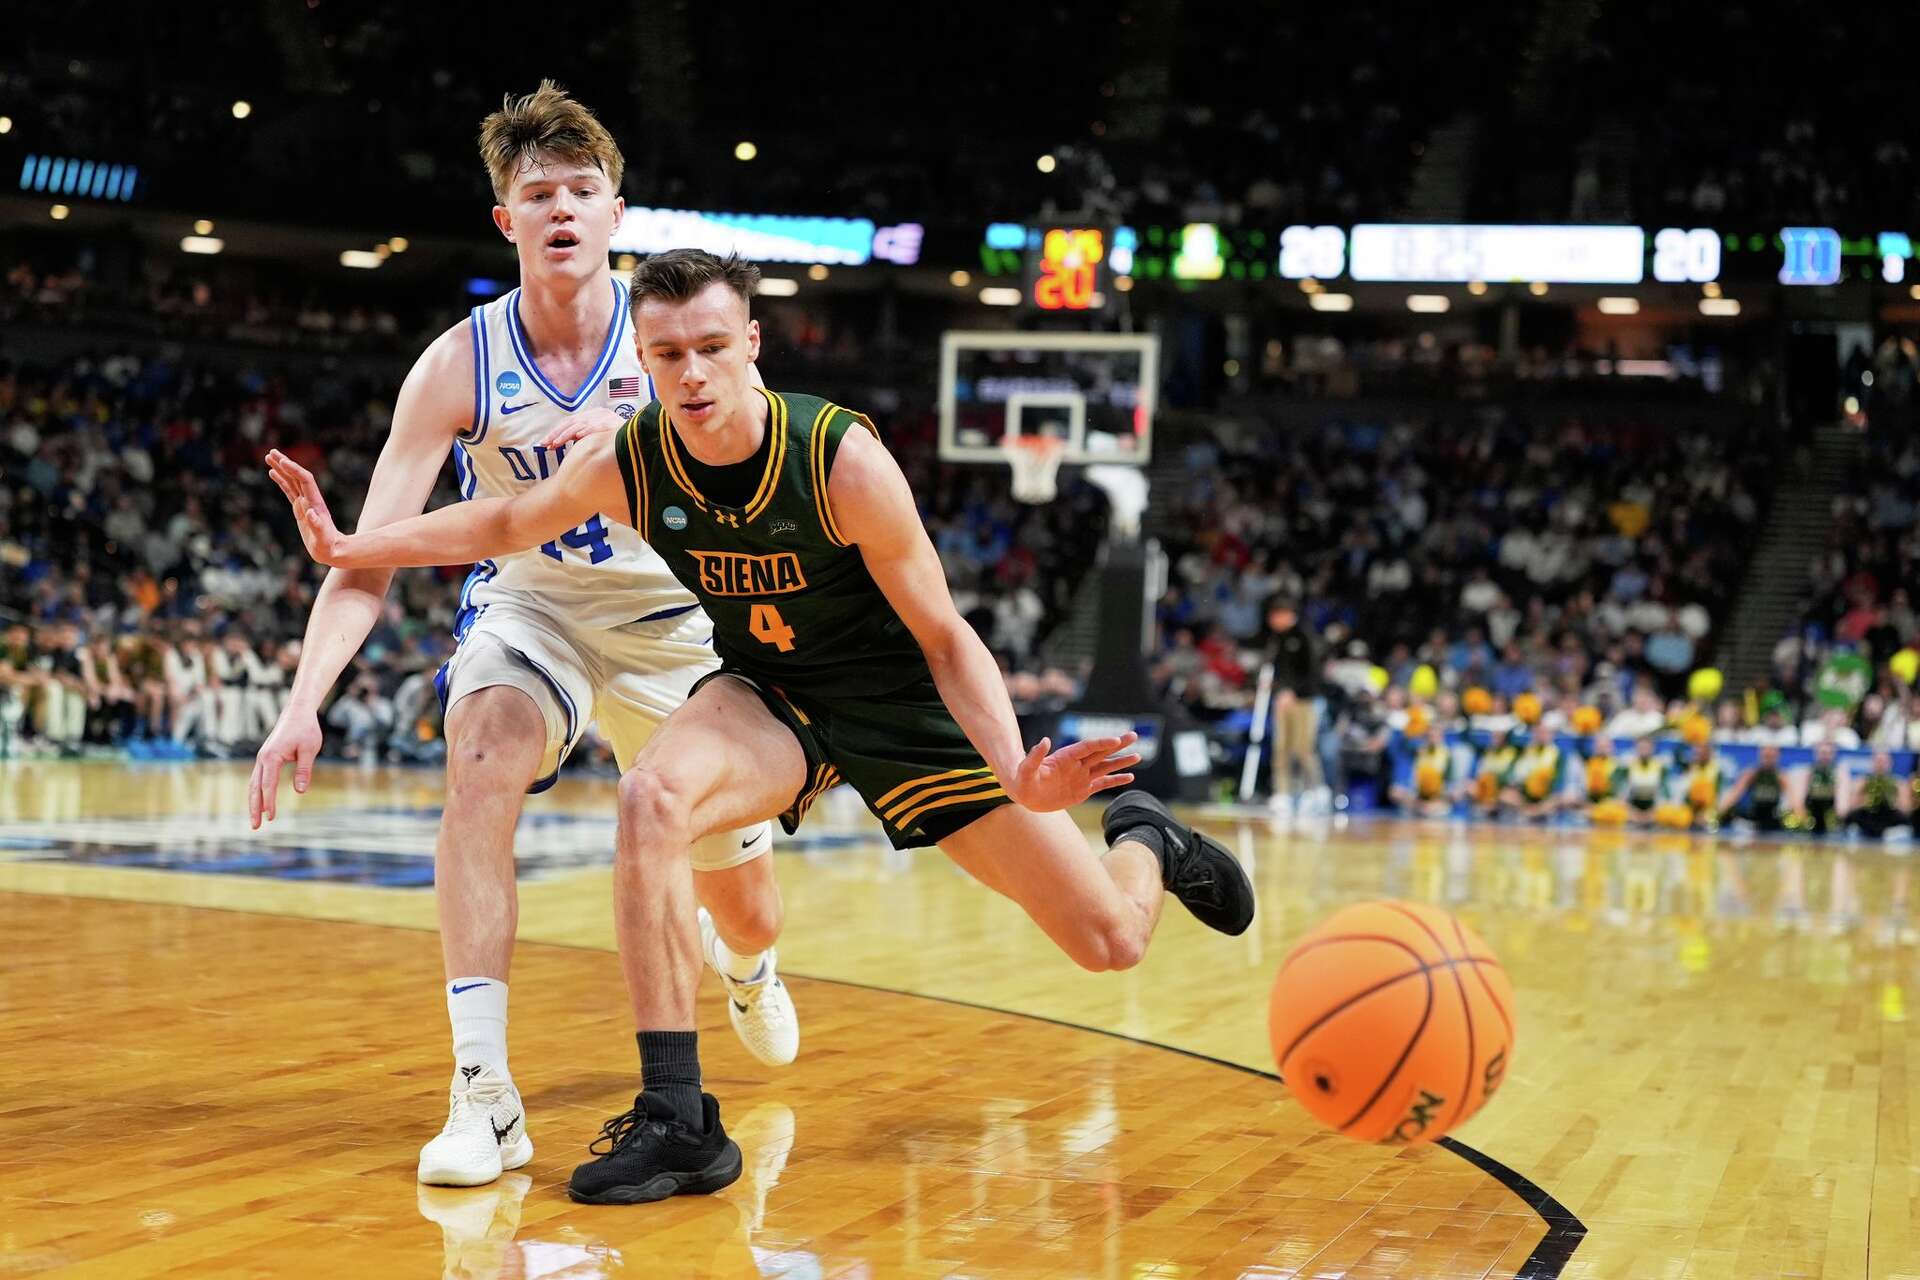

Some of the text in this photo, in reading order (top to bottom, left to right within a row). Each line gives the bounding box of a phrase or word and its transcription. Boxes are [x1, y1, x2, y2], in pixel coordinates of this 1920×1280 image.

[1654, 229, 1721, 282] 20
[498, 440, 578, 481] DU
[702, 555, 803, 593] SIENA
[749, 604, 796, 653] 4
